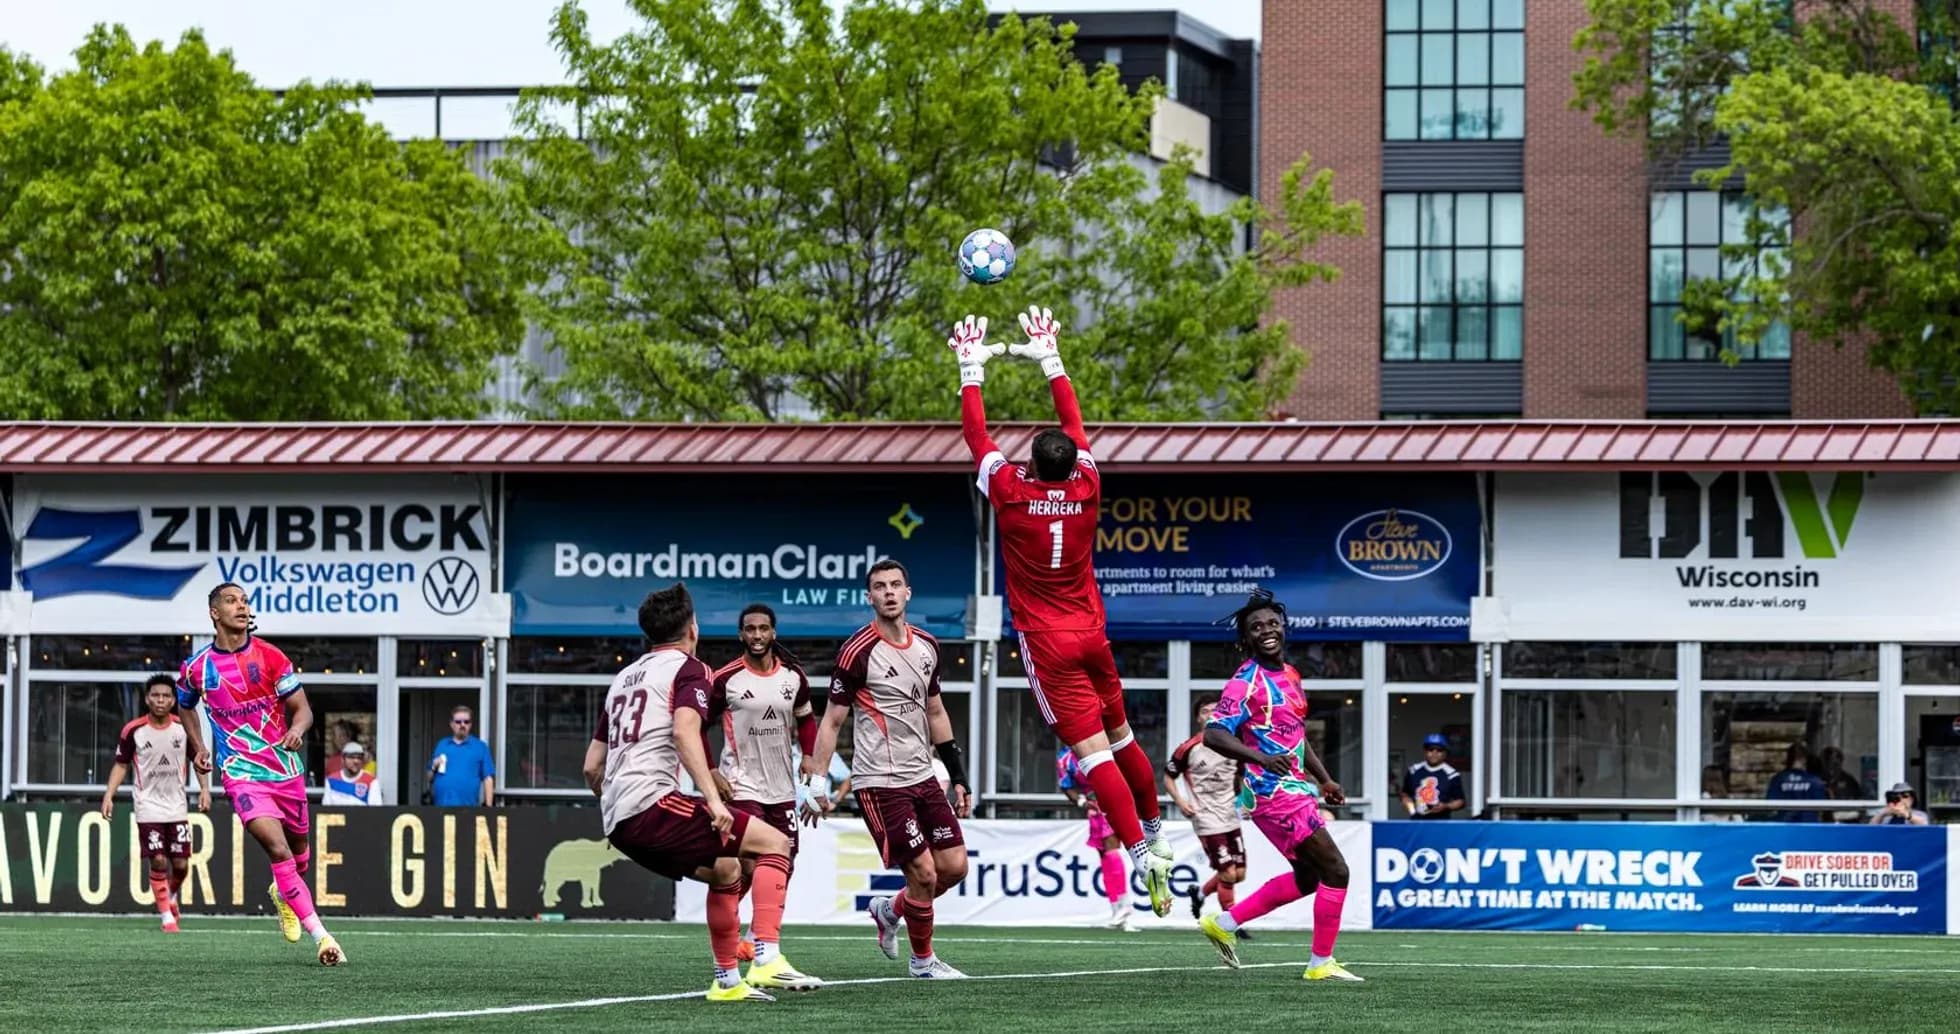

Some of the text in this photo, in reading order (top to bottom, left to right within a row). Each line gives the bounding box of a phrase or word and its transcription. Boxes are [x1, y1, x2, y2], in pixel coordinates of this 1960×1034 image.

[1028, 500, 1083, 516] HERRERA
[1097, 497, 1252, 523] FOR YOUR
[1619, 471, 1863, 559] DAV
[150, 505, 486, 553] ZIMBRICK
[1366, 507, 1420, 540] Steve
[1048, 519, 1064, 569] 1
[1097, 526, 1190, 552] MOVE
[1348, 540, 1442, 561] BROWN
[217, 555, 416, 590] Volkswagen
[1094, 564, 1276, 579] rtments to room for what's
[1676, 565, 1820, 588] Wisconsin
[782, 588, 872, 605] LAW FIR
[1102, 582, 1174, 597] apartment
[1175, 580, 1214, 597] living
[1688, 596, 1807, 611] www.dav-wi.org
[1327, 615, 1471, 628] STEVEBROWNAPTS.COM
[622, 670, 647, 689] SILVA
[609, 688, 649, 750] 33
[0, 811, 508, 909] VOURIE GIN
[1536, 849, 1704, 887] WRECK
[1785, 854, 1890, 870] DRIVE SOBER OR
[1804, 873, 1916, 889] GET PULLED OVER
[1376, 888, 1704, 912] A GREAT TIME AT THE MATCH.
[1732, 902, 1768, 913] LEARN
[1768, 903, 1800, 913] MORE
[1801, 903, 1816, 913] AT
